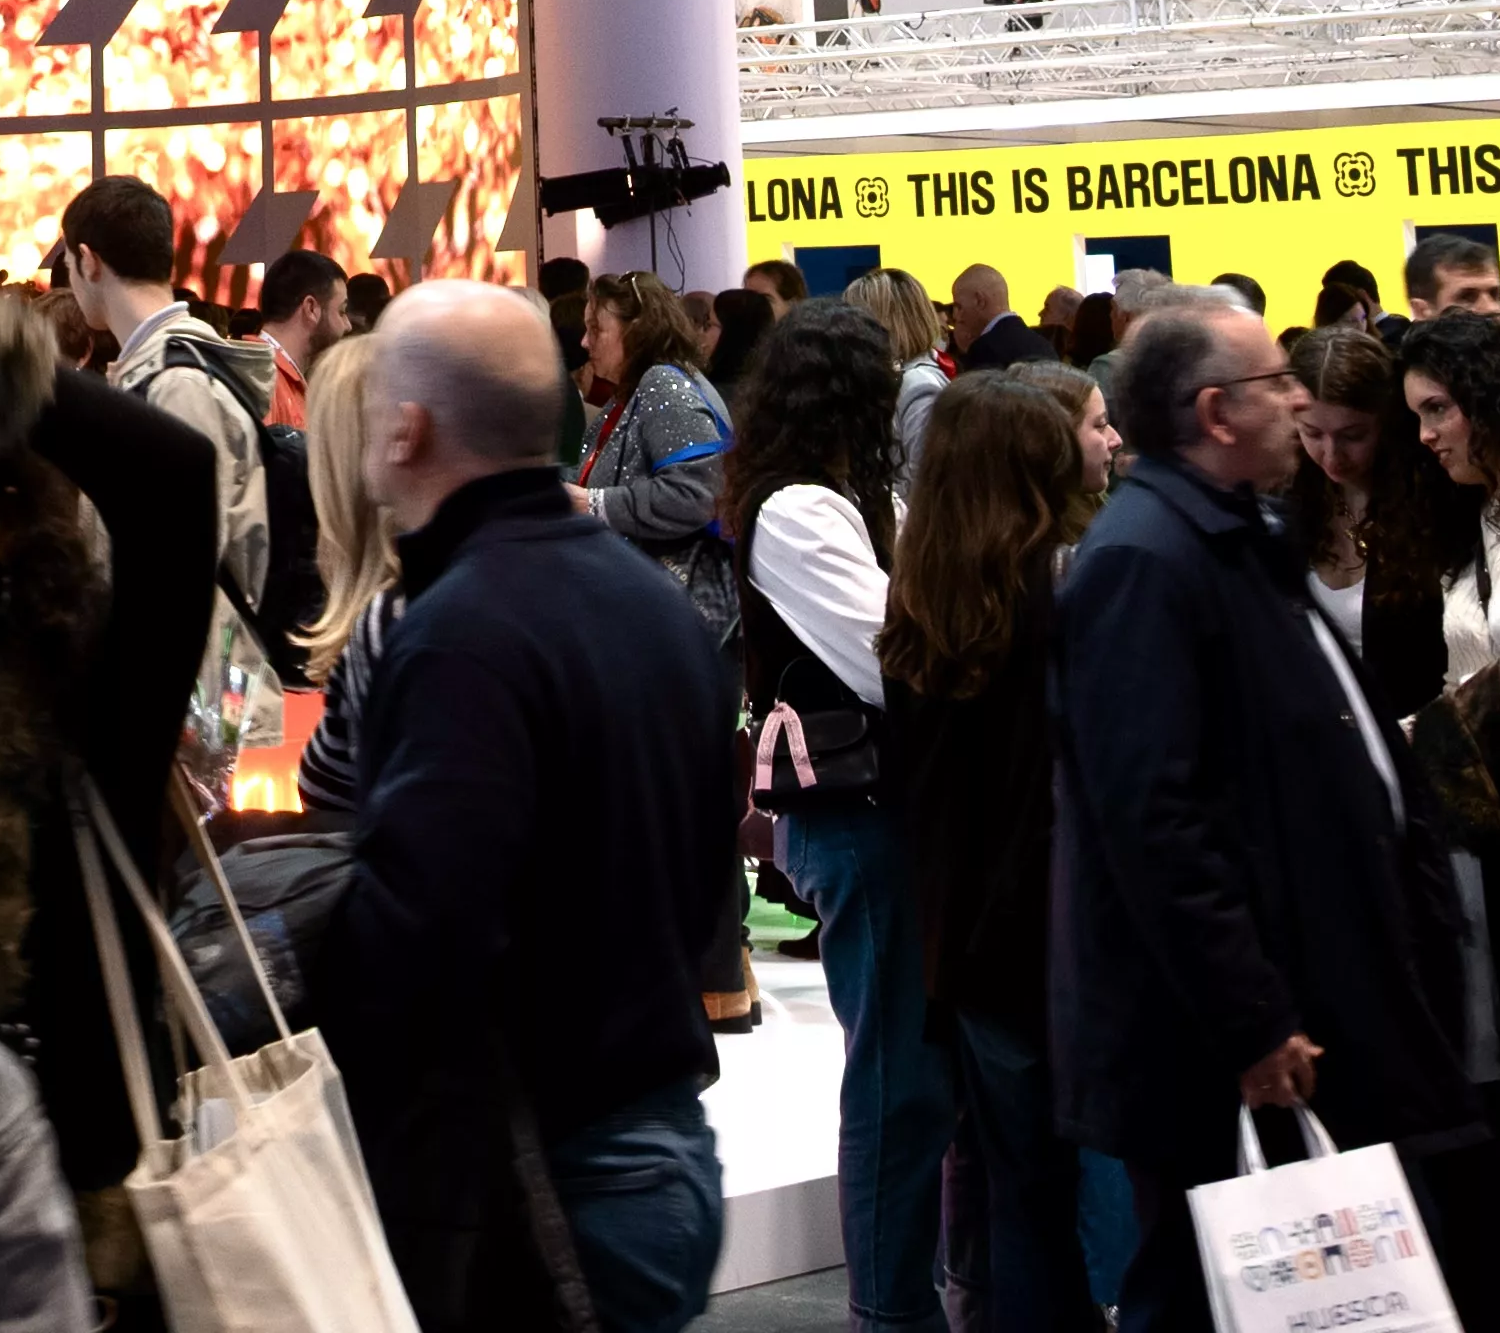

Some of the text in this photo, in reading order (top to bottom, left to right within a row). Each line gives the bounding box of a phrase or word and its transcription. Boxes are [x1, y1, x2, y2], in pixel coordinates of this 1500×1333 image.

[906, 170, 996, 218] THIS
[1012, 167, 1050, 214] IS
[1066, 153, 1321, 211] BARCELONA
